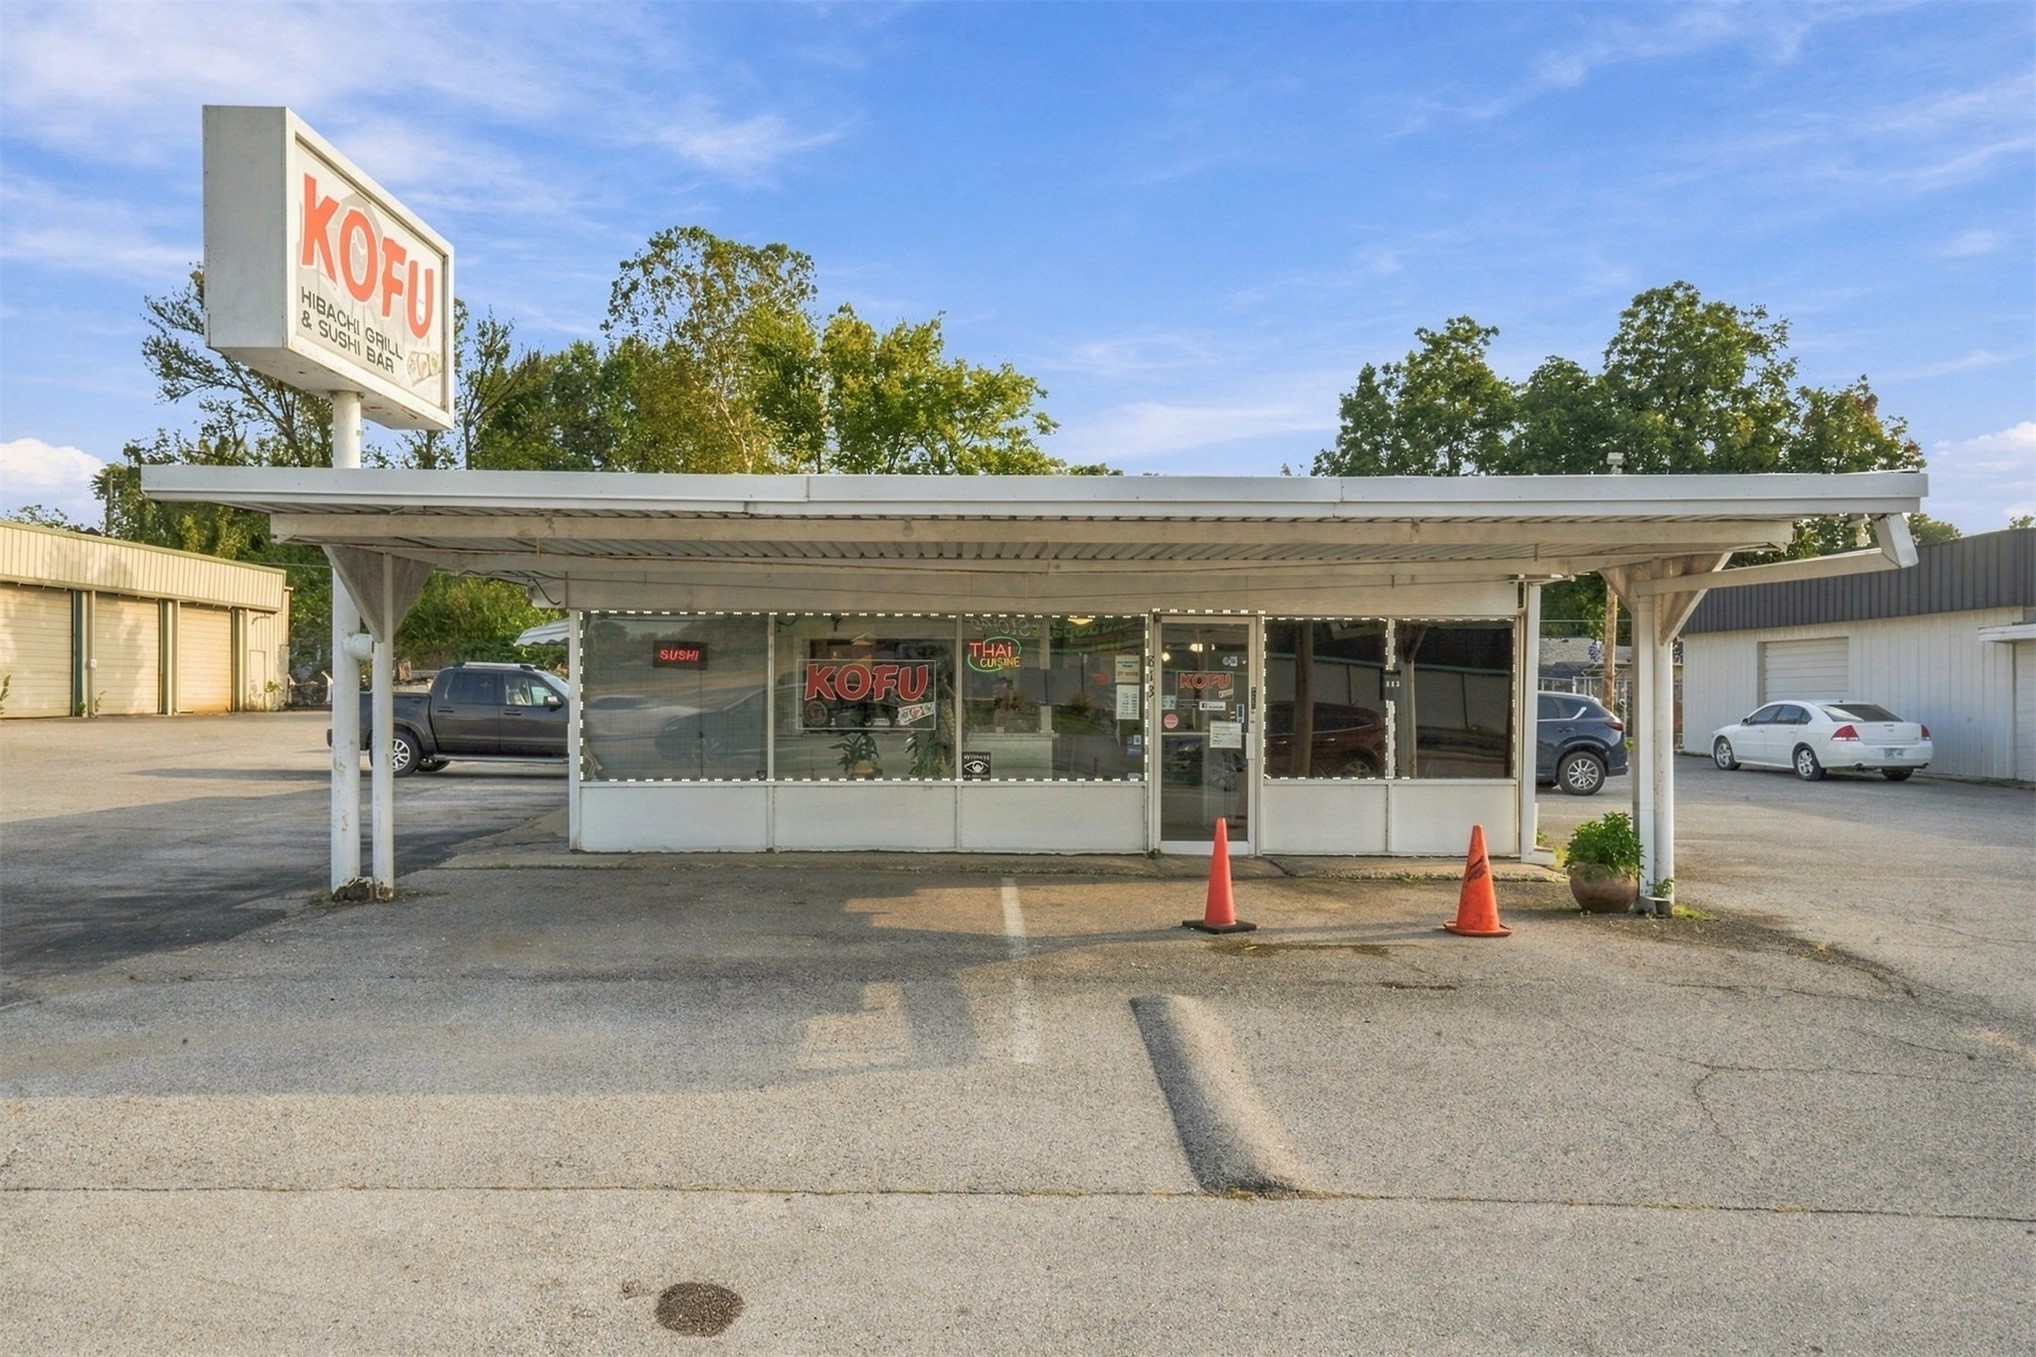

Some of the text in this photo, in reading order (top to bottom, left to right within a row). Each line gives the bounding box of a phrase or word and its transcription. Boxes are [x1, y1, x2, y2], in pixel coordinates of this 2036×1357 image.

[302, 172, 434, 340] KOFU
[301, 286, 403, 361] HIBACHI GRILL
[301, 310, 395, 374] & SUSHI BAR
[659, 648, 699, 662] SUSHI
[979, 656, 1021, 669] CUISINE
[804, 663, 929, 701] KOFU
[1179, 672, 1232, 690] KOFU
